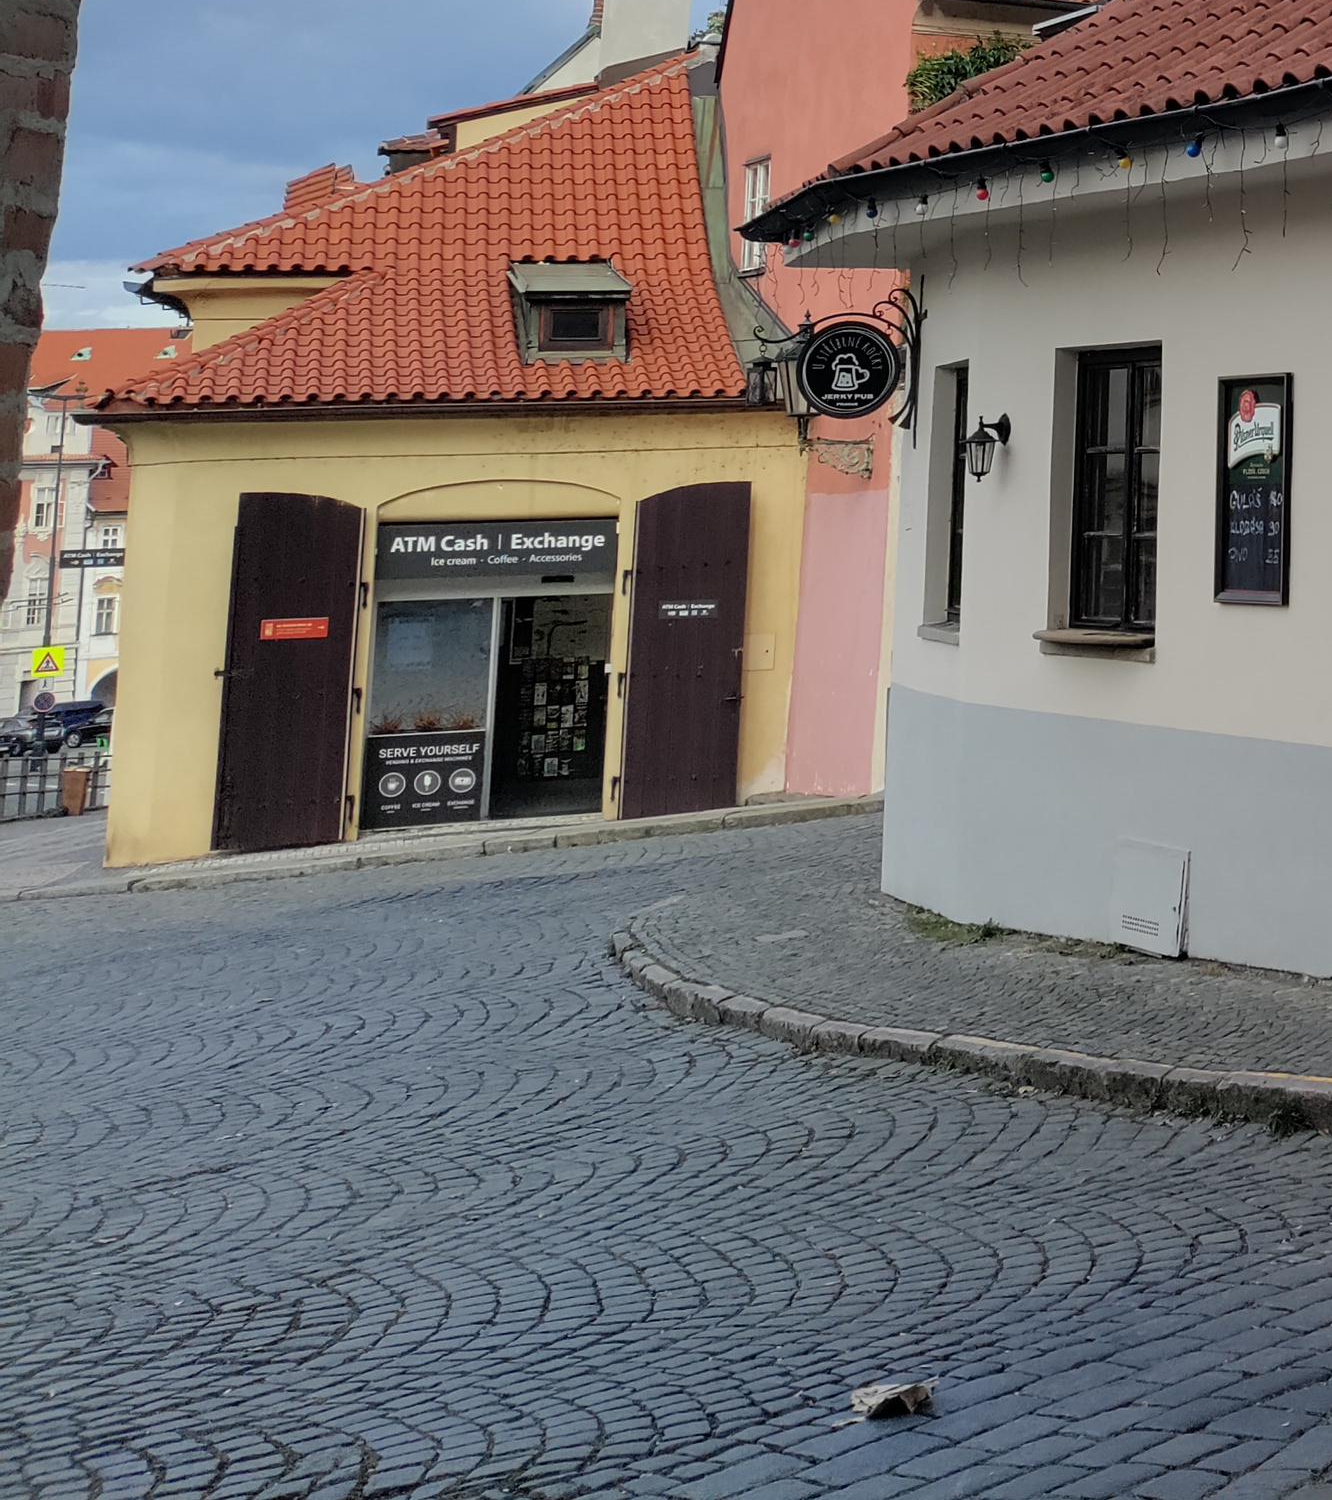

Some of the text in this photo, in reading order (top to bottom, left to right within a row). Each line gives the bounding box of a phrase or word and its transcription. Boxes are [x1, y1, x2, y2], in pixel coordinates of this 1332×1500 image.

[391, 532, 605, 553] ATM Cash Exchange
[431, 553, 583, 566] Ice cream Coffee Accessories
[379, 743, 480, 759] SERVE YOURSELF
